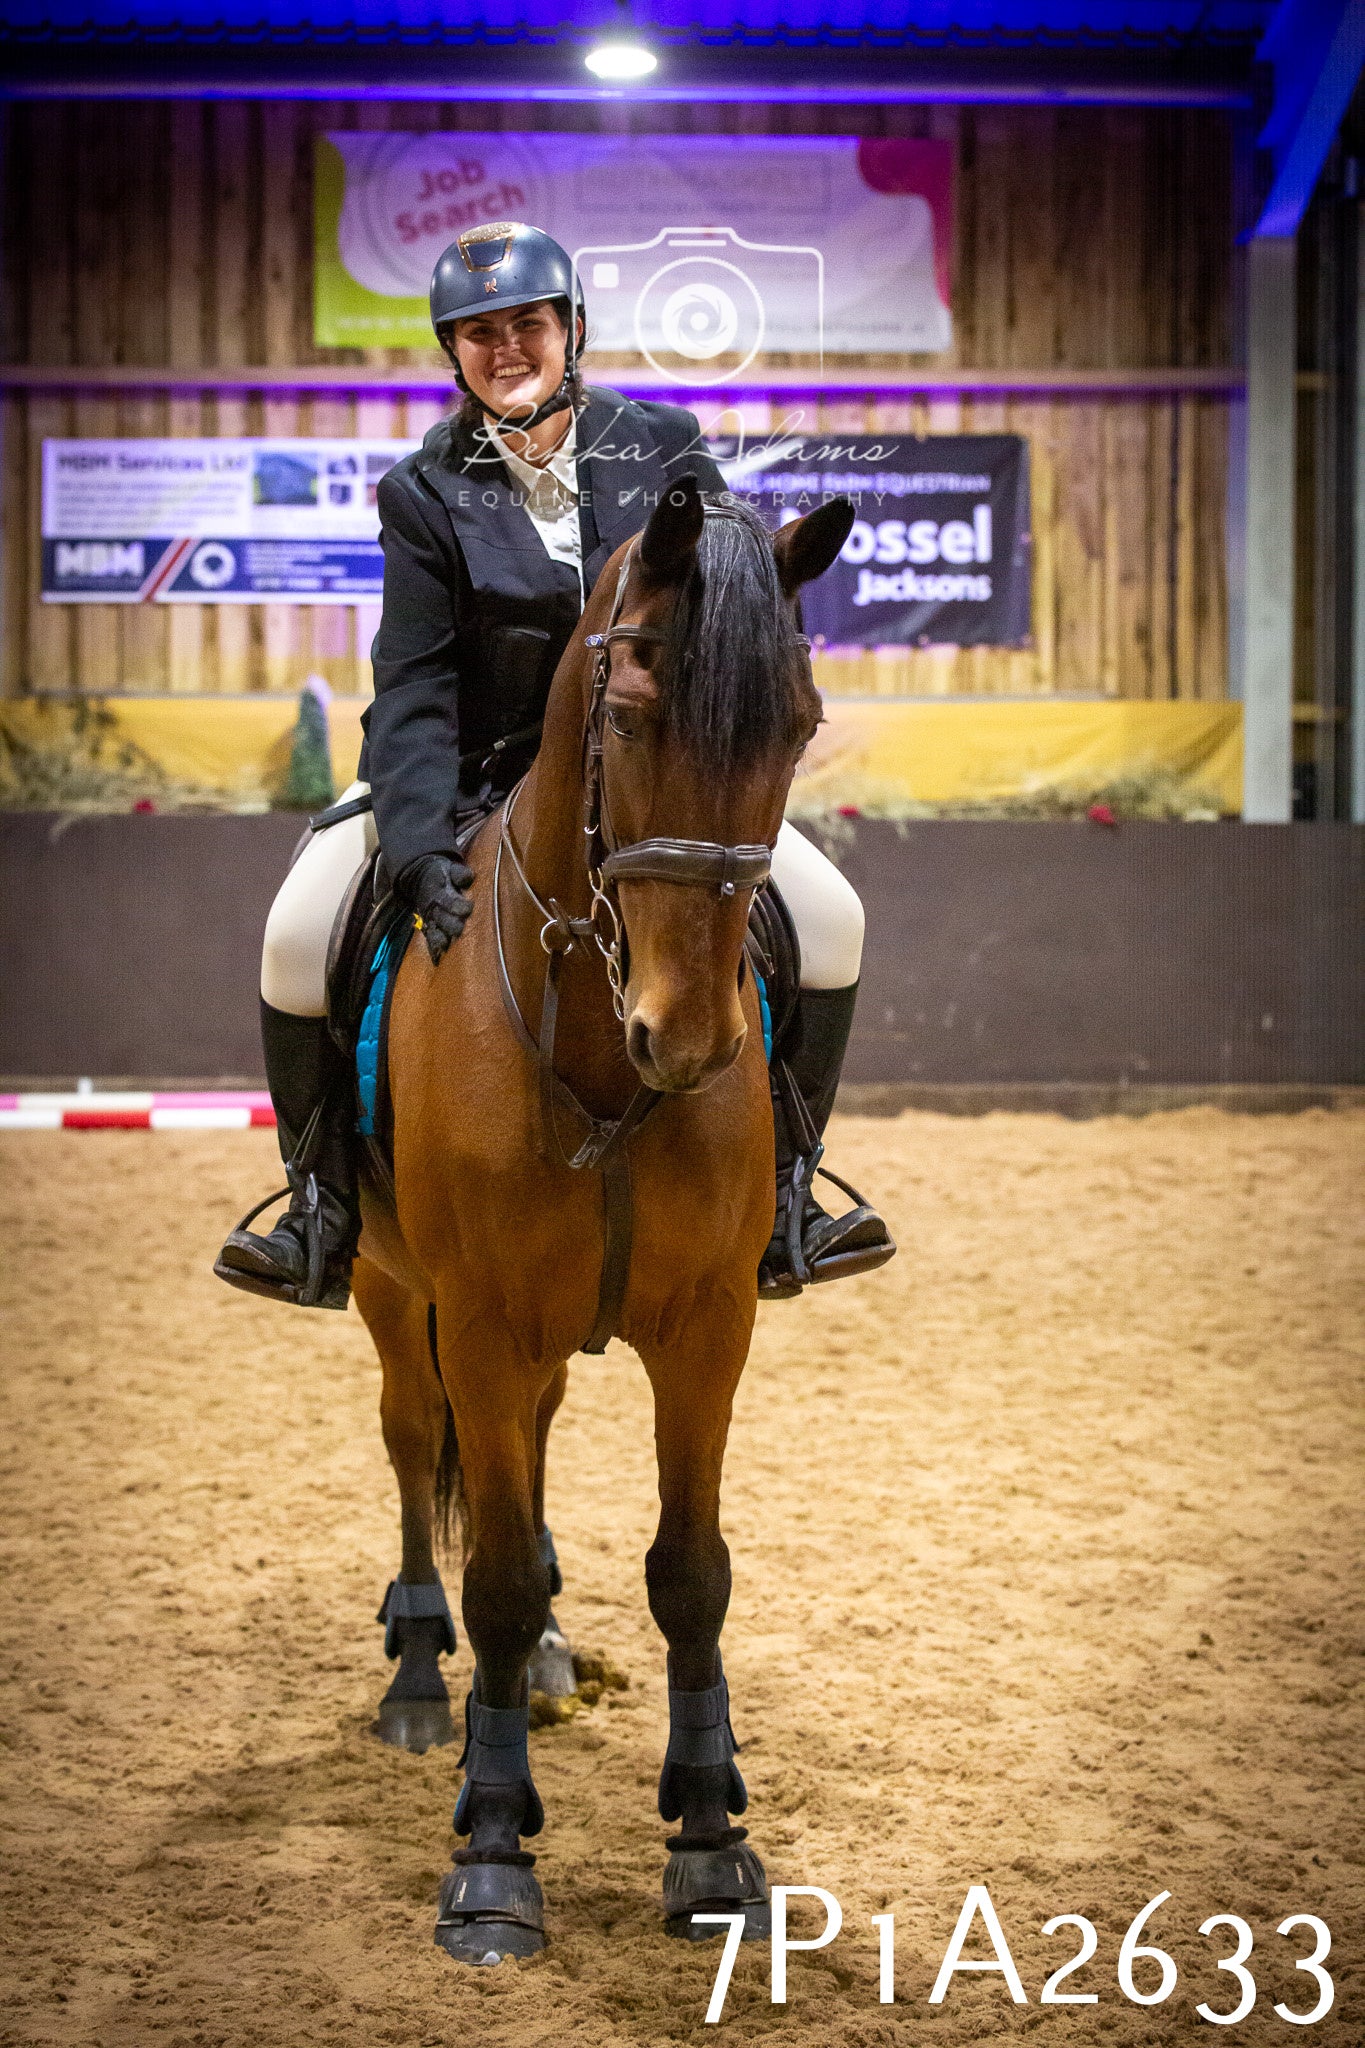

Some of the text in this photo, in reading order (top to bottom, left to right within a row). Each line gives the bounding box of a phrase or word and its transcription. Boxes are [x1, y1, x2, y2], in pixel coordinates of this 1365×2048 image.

[420, 158, 486, 203] Job
[396, 180, 527, 244] Search
[853, 566, 993, 606] Jacksons
